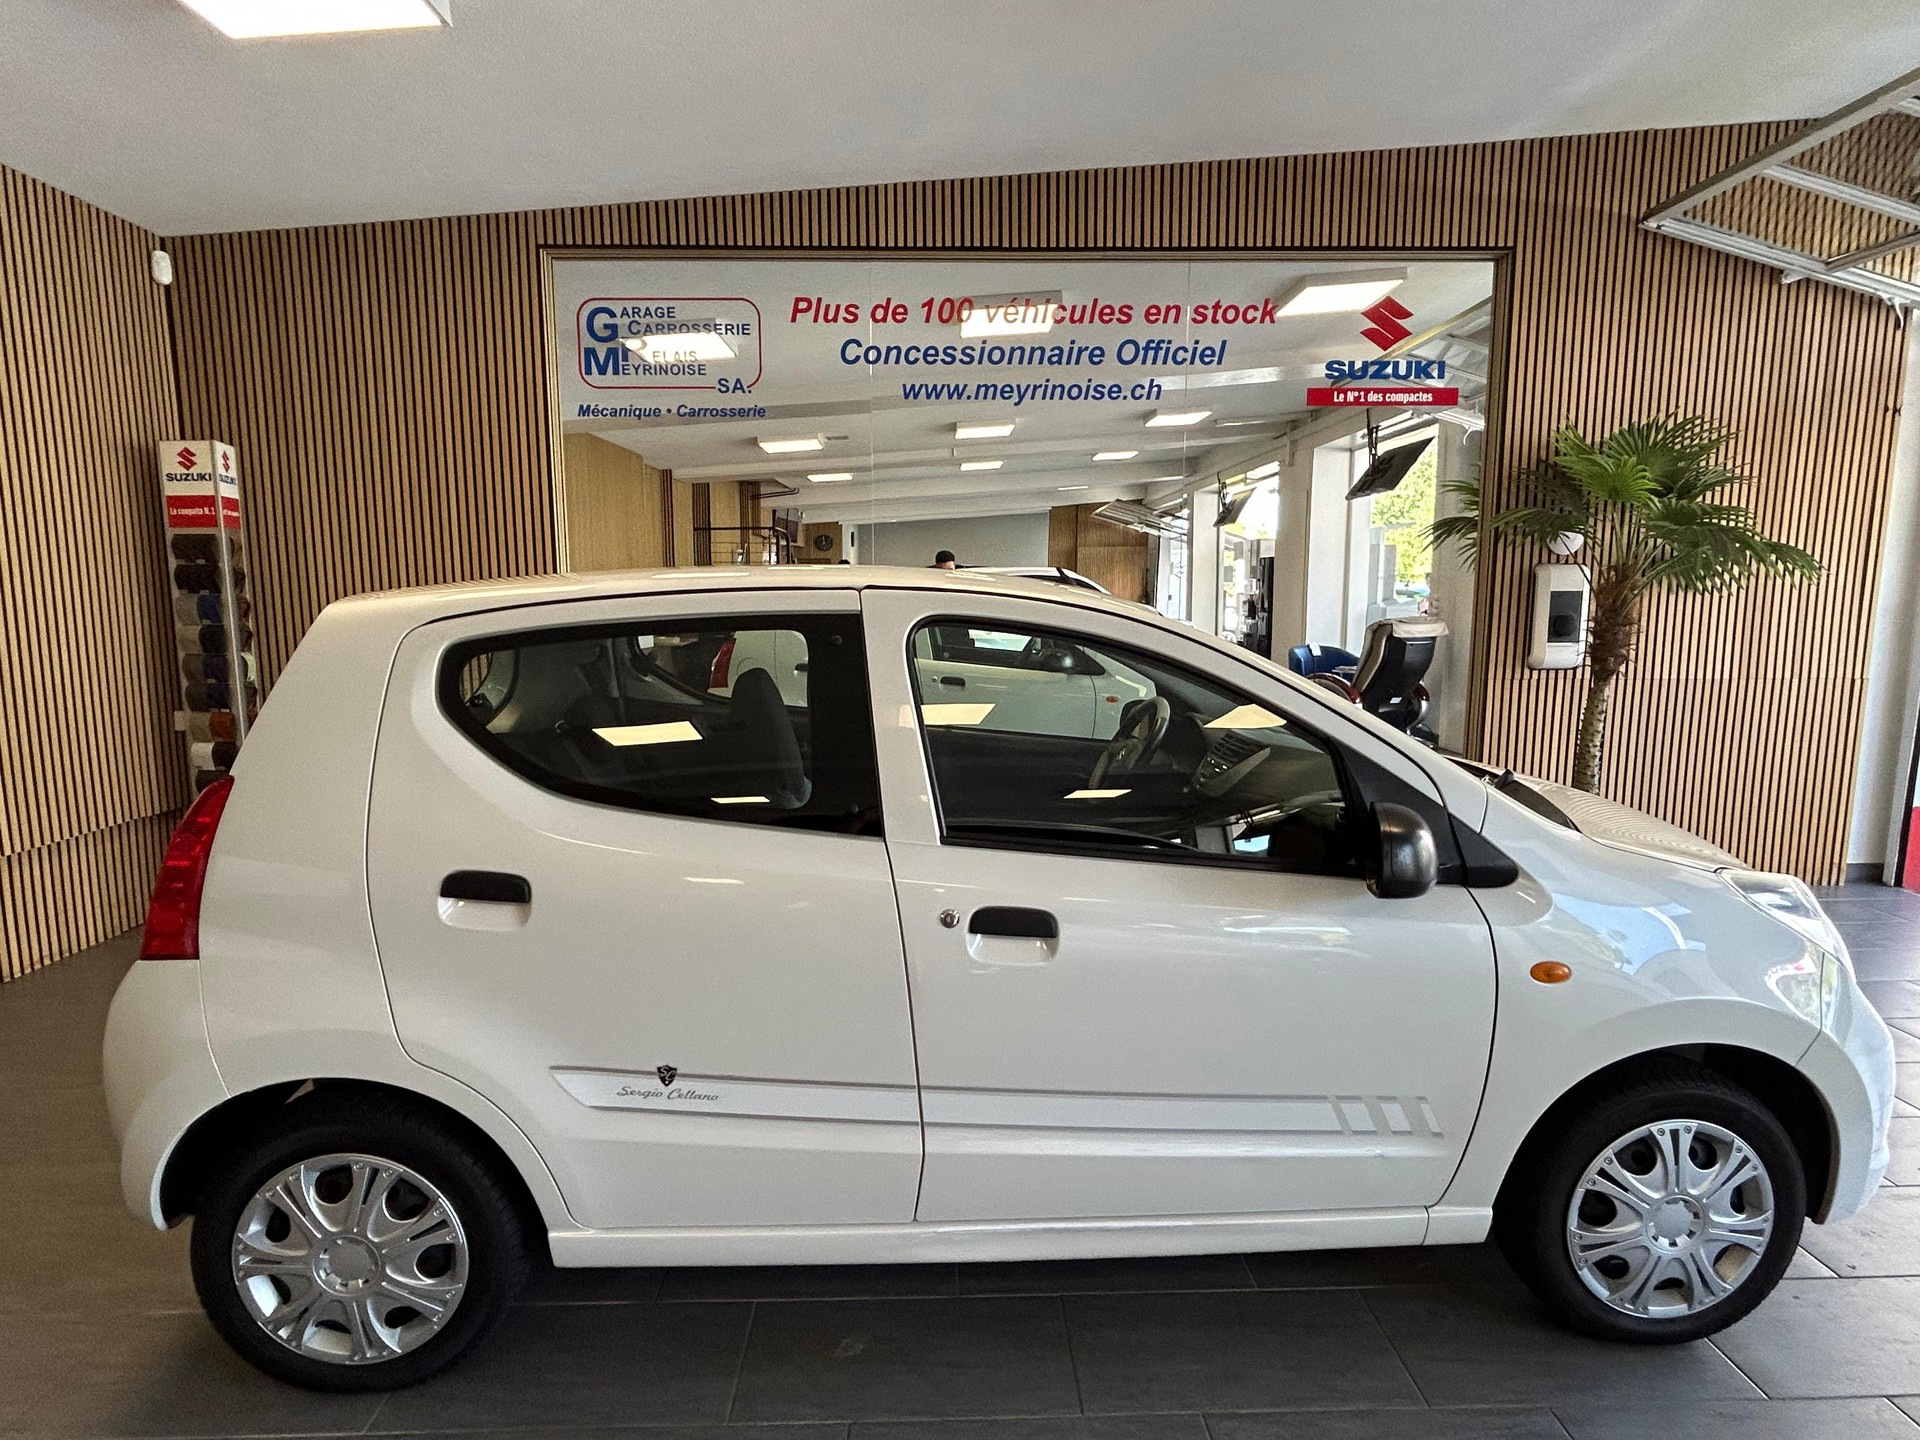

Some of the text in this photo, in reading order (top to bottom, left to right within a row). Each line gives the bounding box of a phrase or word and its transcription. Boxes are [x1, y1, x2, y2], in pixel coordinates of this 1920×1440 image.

[789, 296, 1280, 325] Plus de 100 véhicules en stock
[586, 306, 676, 343] GARAGE
[627, 320, 751, 336] CARROSSERIE
[583, 347, 707, 376] MEYRINOISE
[840, 338, 1228, 366] Concessionnaire Officiel
[1324, 360, 1446, 380] SUZUKI
[901, 378, 1163, 407] www.meyrinoise.ch
[1333, 391, 1345, 402] Le
[1367, 391, 1383, 402] des
[1385, 391, 1433, 404] compactes
[577, 403, 766, 420] Mécanique Carrosserie
[165, 473, 212, 482] SUZUKI
[616, 1085, 719, 1101] Sergio Cellano
